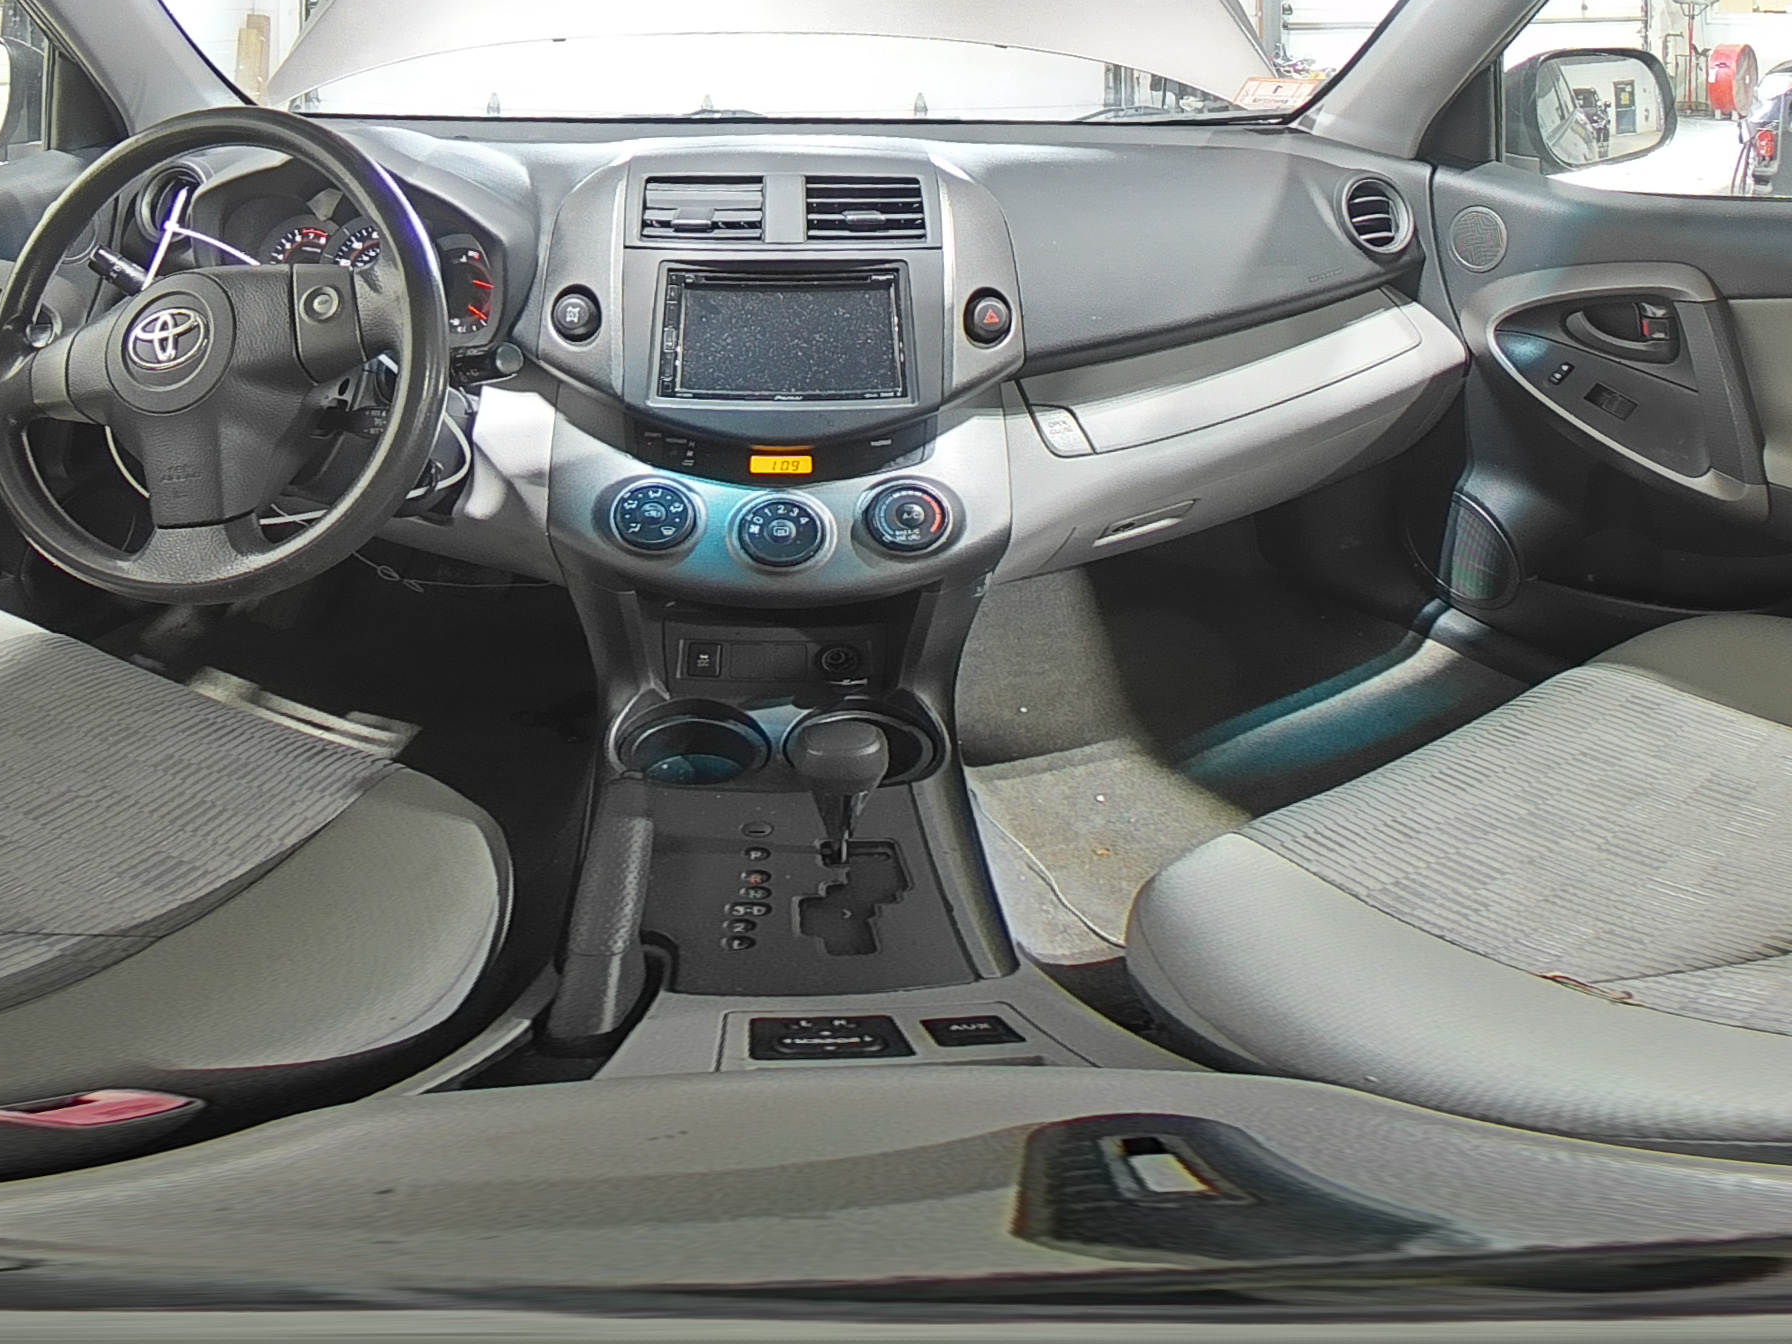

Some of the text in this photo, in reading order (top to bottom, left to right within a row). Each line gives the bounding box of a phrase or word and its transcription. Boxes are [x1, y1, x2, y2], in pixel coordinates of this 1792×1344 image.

[752, 516, 764, 524] 0
[764, 507, 772, 517] 1
[777, 505, 785, 514] 2
[789, 507, 800, 517] 3
[750, 852, 761, 860] P
[749, 874, 761, 885] R
[749, 889, 761, 899] N
[733, 923, 746, 933] 2
[948, 1021, 992, 1032] AUX
